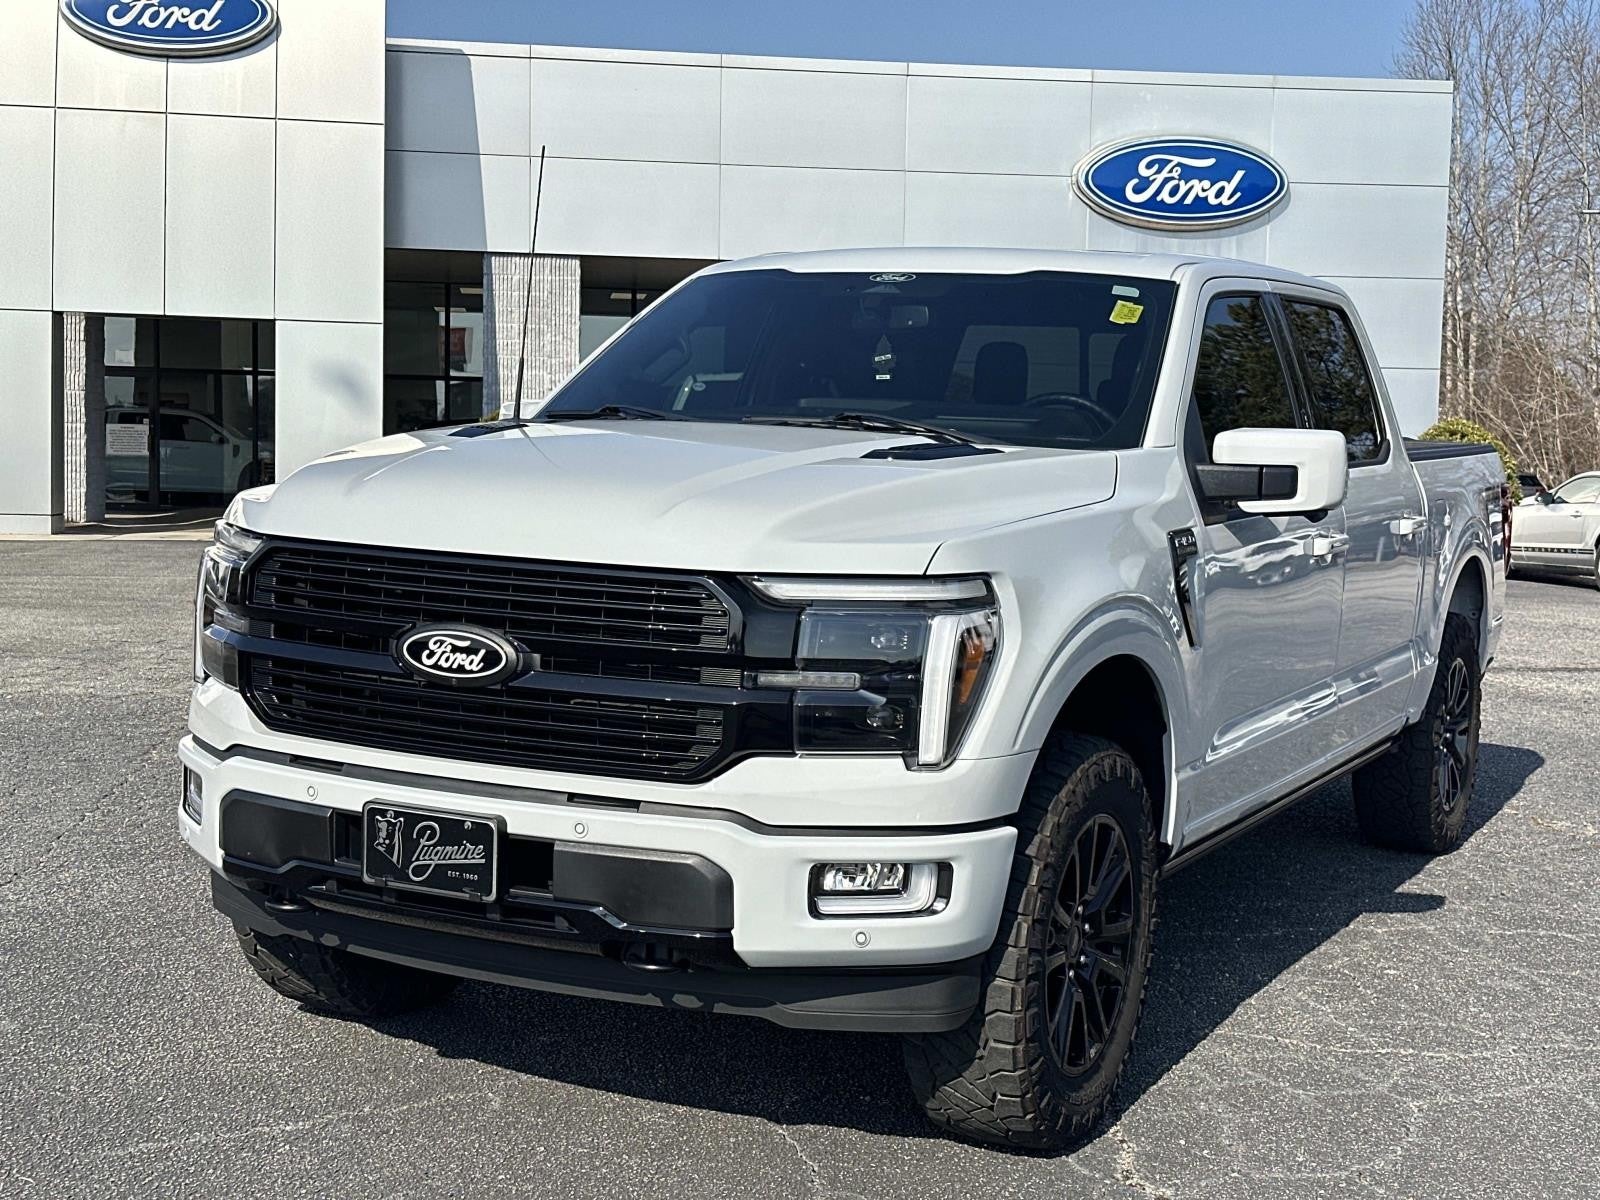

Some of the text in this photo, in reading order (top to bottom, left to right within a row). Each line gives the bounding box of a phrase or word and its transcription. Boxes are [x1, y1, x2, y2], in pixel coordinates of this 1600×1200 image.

[107, 0, 221, 31] Ford
[1125, 154, 1246, 206] Ford
[421, 636, 486, 671] Ford
[408, 821, 486, 882] Pugmire
[447, 870, 461, 879] EST.
